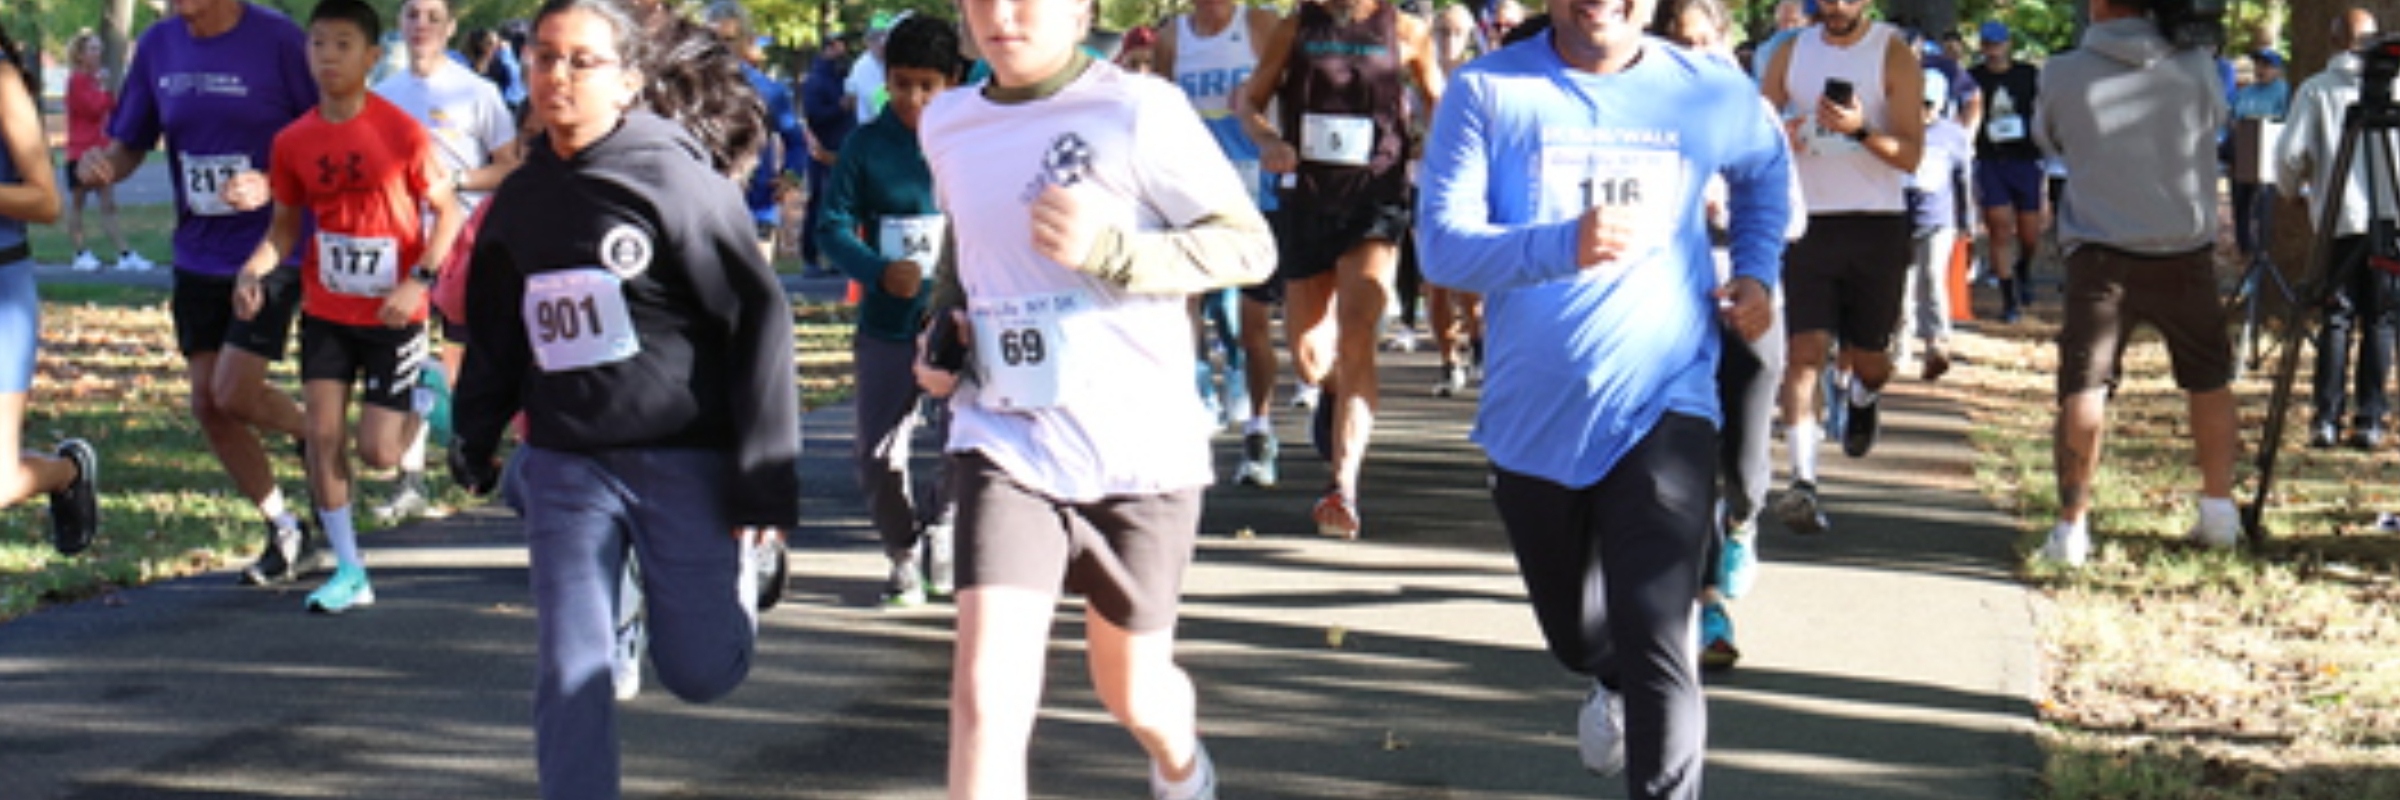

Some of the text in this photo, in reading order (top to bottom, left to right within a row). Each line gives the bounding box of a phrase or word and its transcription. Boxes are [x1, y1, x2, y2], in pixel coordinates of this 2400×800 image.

[331, 247, 380, 275] 177
[537, 294, 603, 343] 901
[999, 329, 1046, 367] 69
